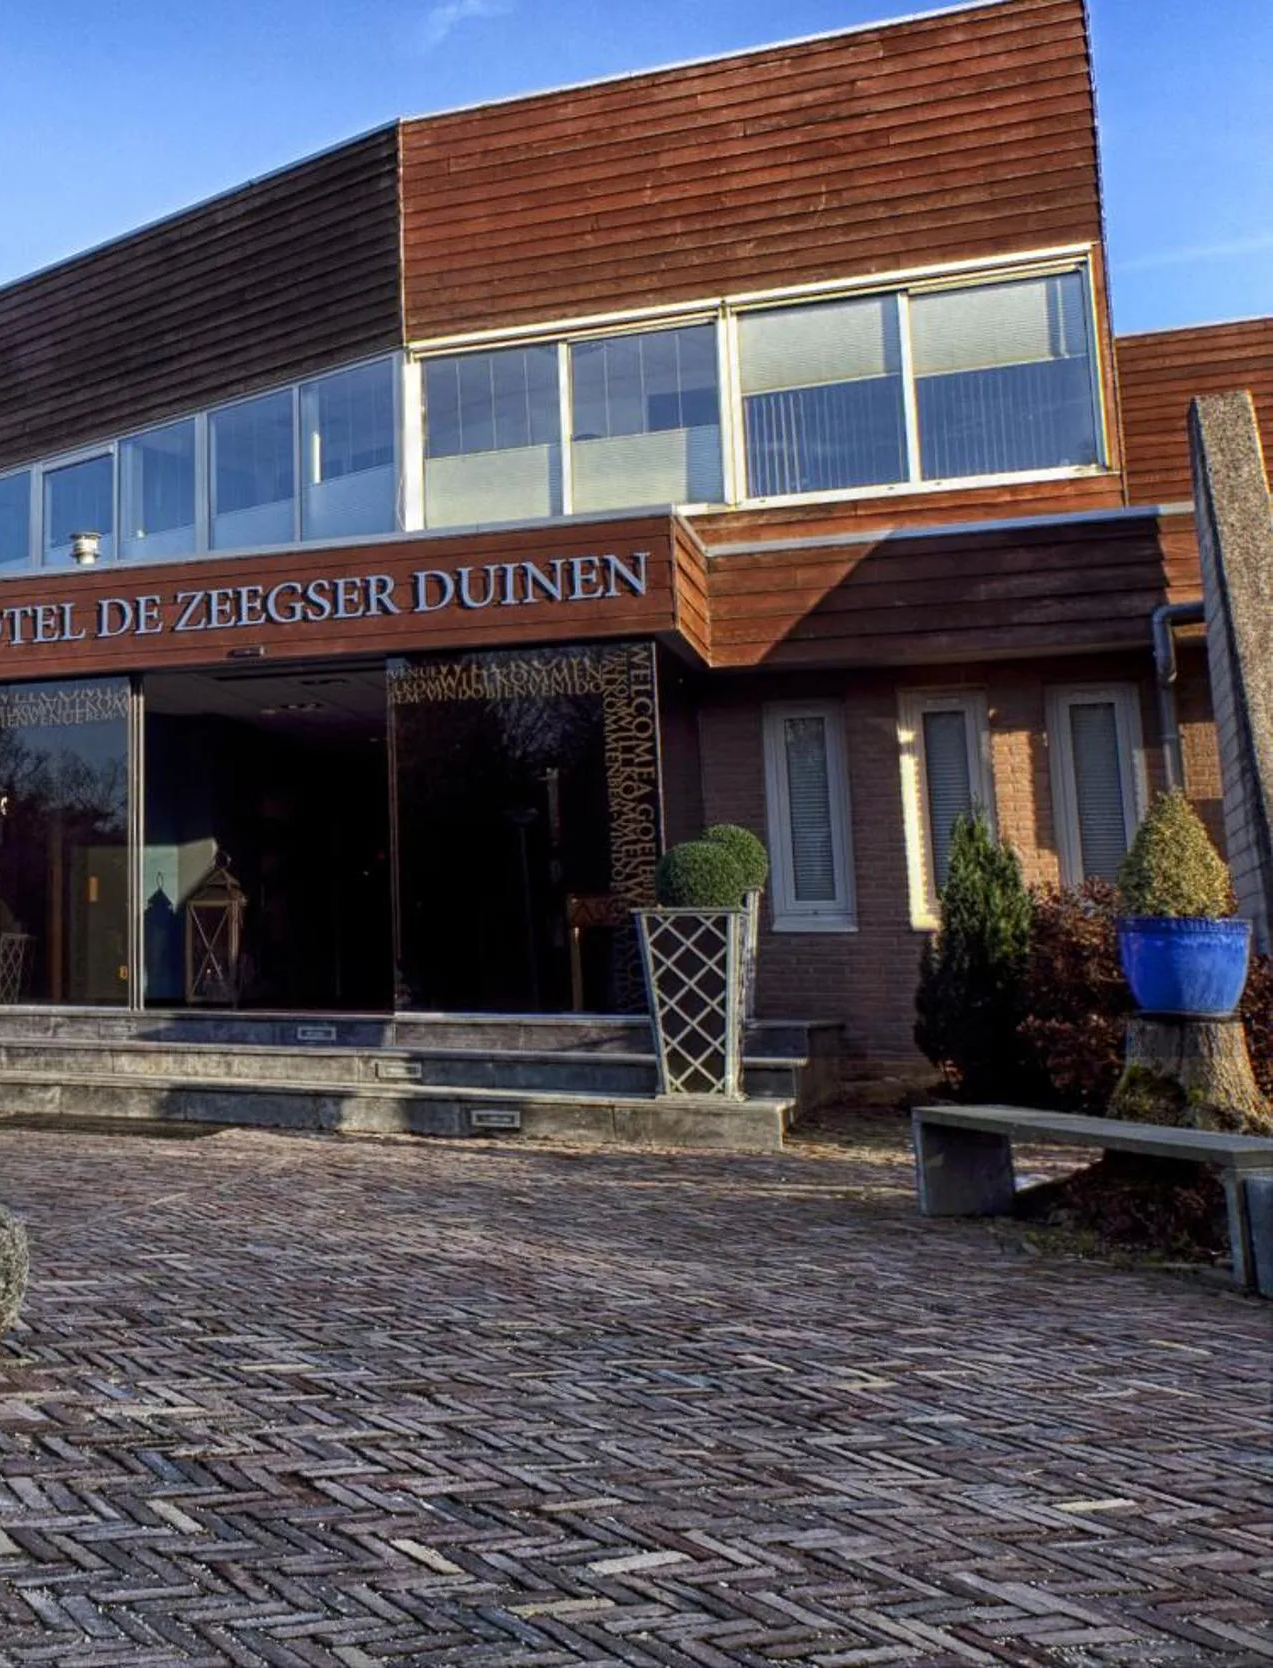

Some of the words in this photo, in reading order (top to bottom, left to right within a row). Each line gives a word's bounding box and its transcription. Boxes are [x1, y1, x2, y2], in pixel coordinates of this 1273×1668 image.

[95, 594, 164, 640] DE
[173, 574, 401, 633] ZEEGSER
[410, 552, 651, 612] DUINEN
[631, 644, 655, 780] WELCOME
